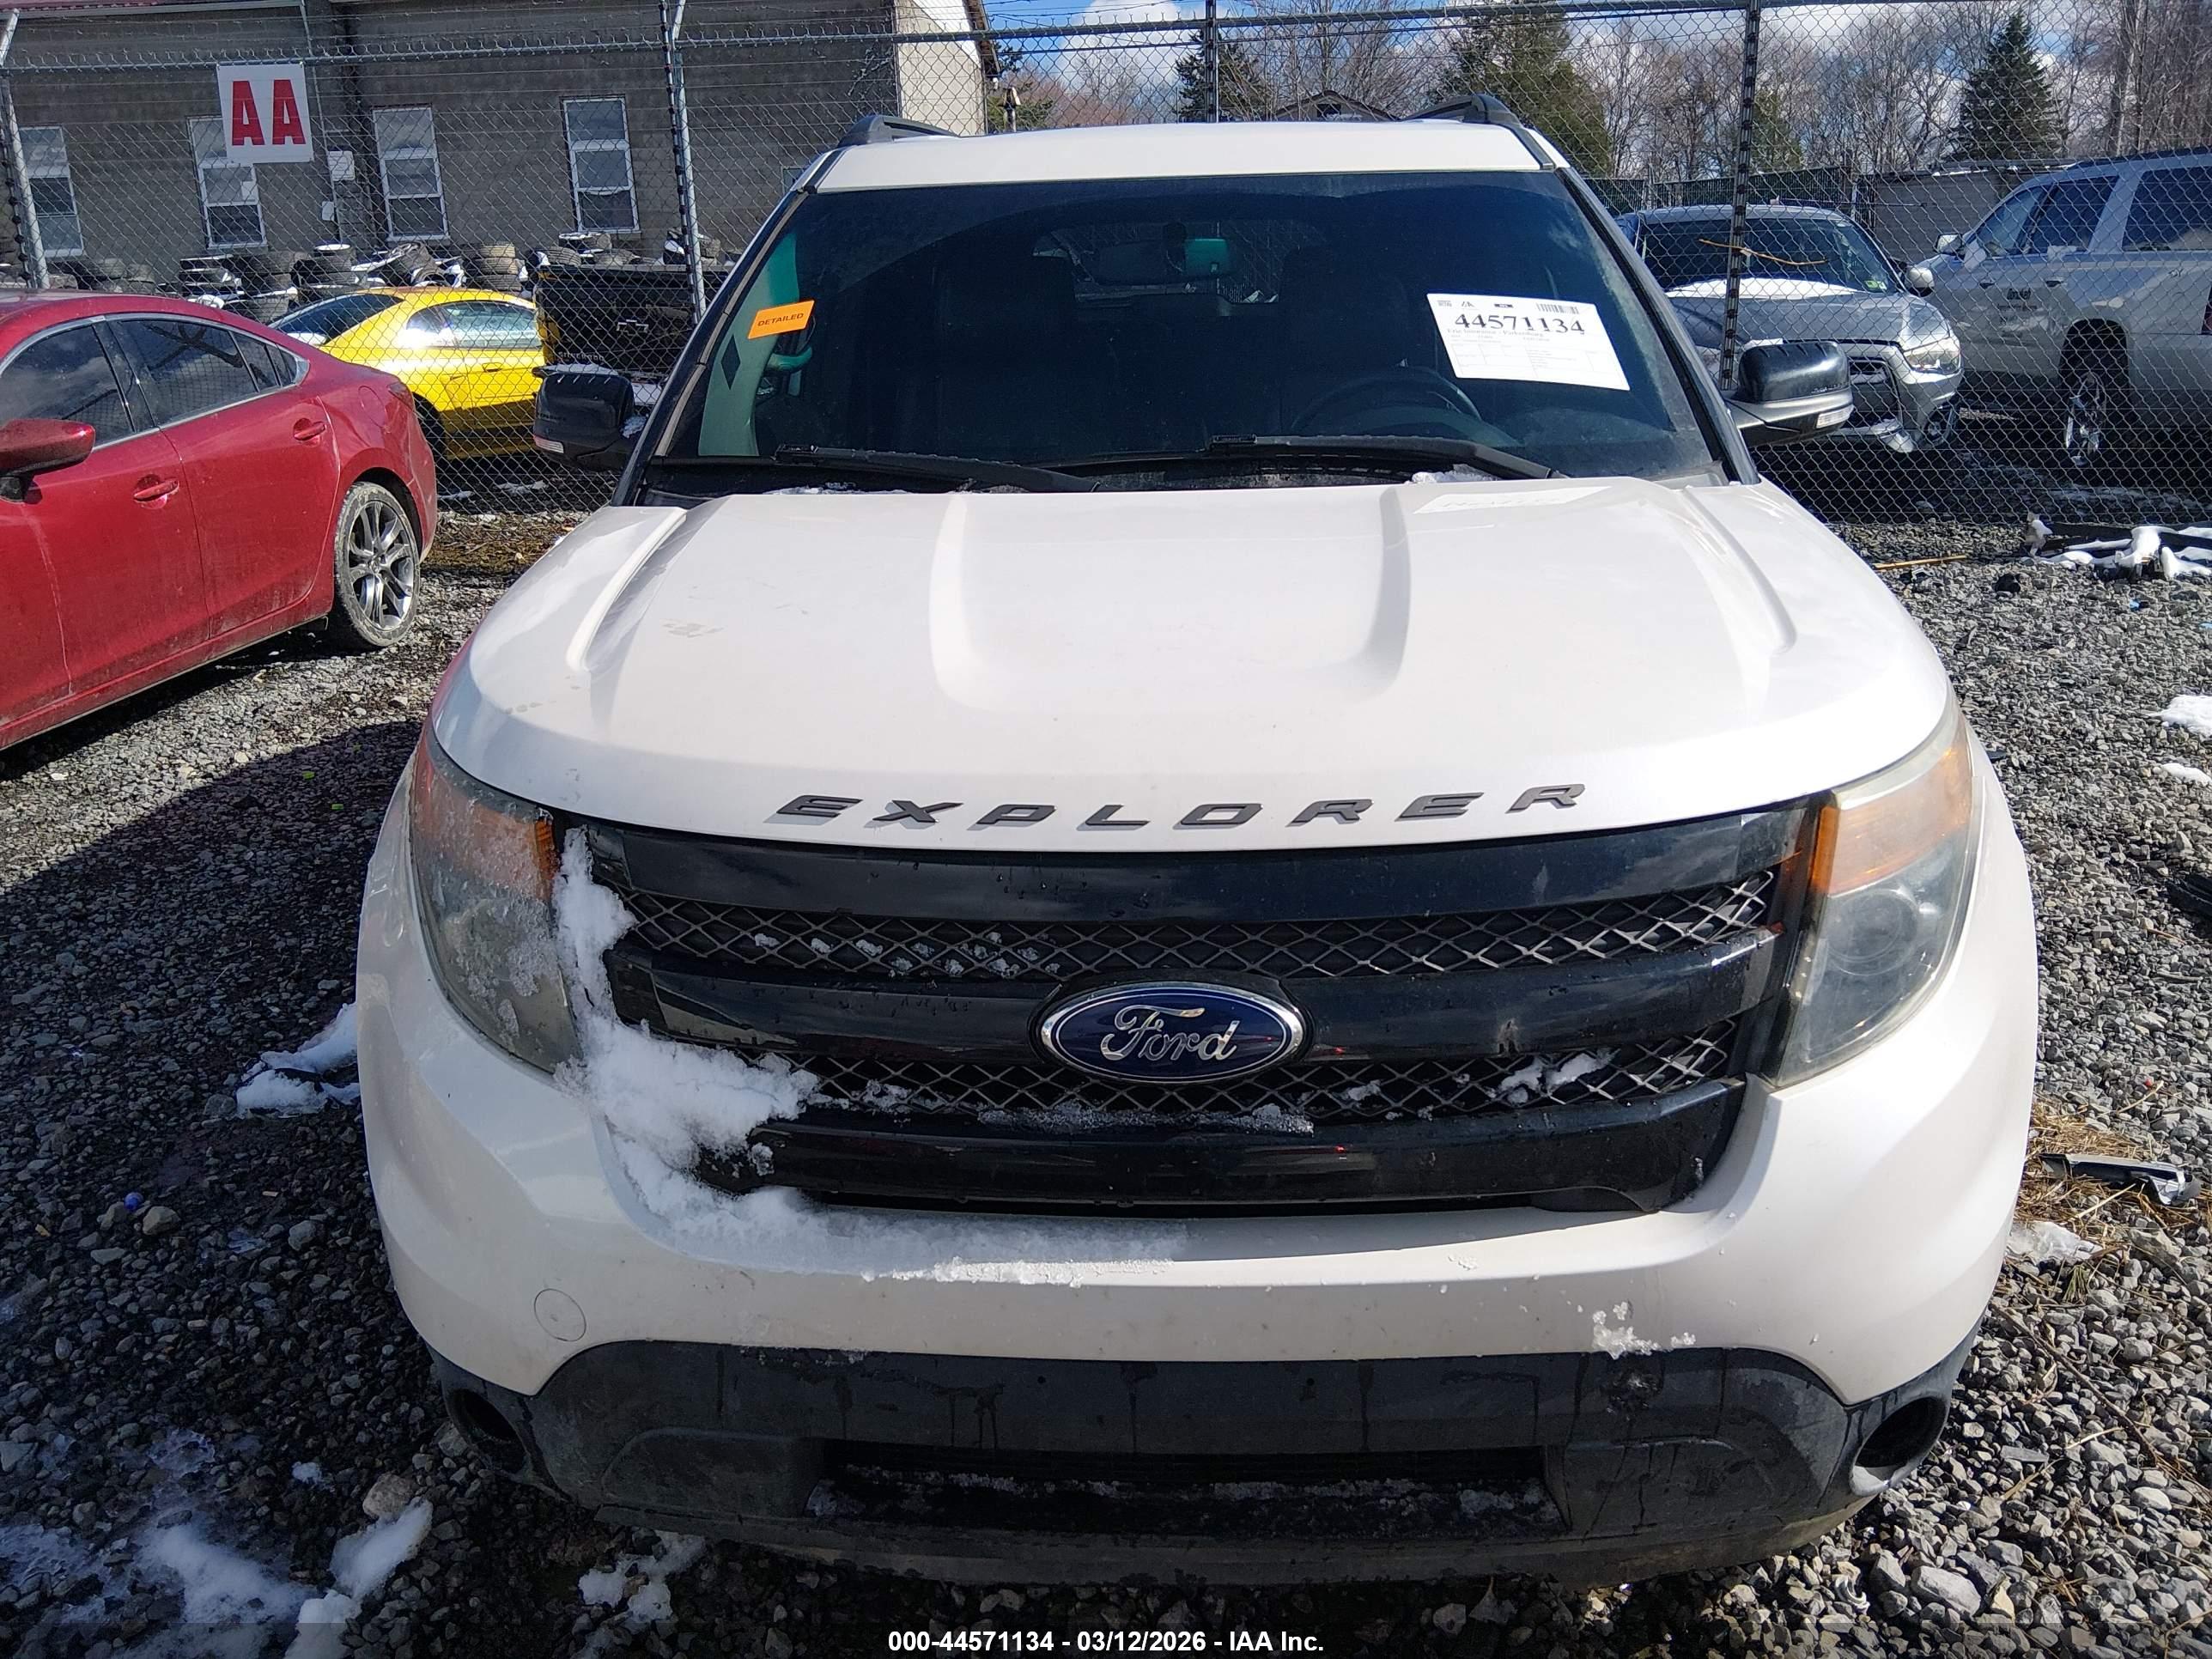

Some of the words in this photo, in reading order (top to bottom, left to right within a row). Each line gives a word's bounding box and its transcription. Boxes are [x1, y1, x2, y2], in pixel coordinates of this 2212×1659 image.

[232, 79, 306, 146] AA
[757, 313, 805, 327] DETAILED
[1454, 313, 1586, 336] 44571134
[775, 783, 1587, 827] EXPLORER
[1100, 1004, 1241, 1061] Ford
